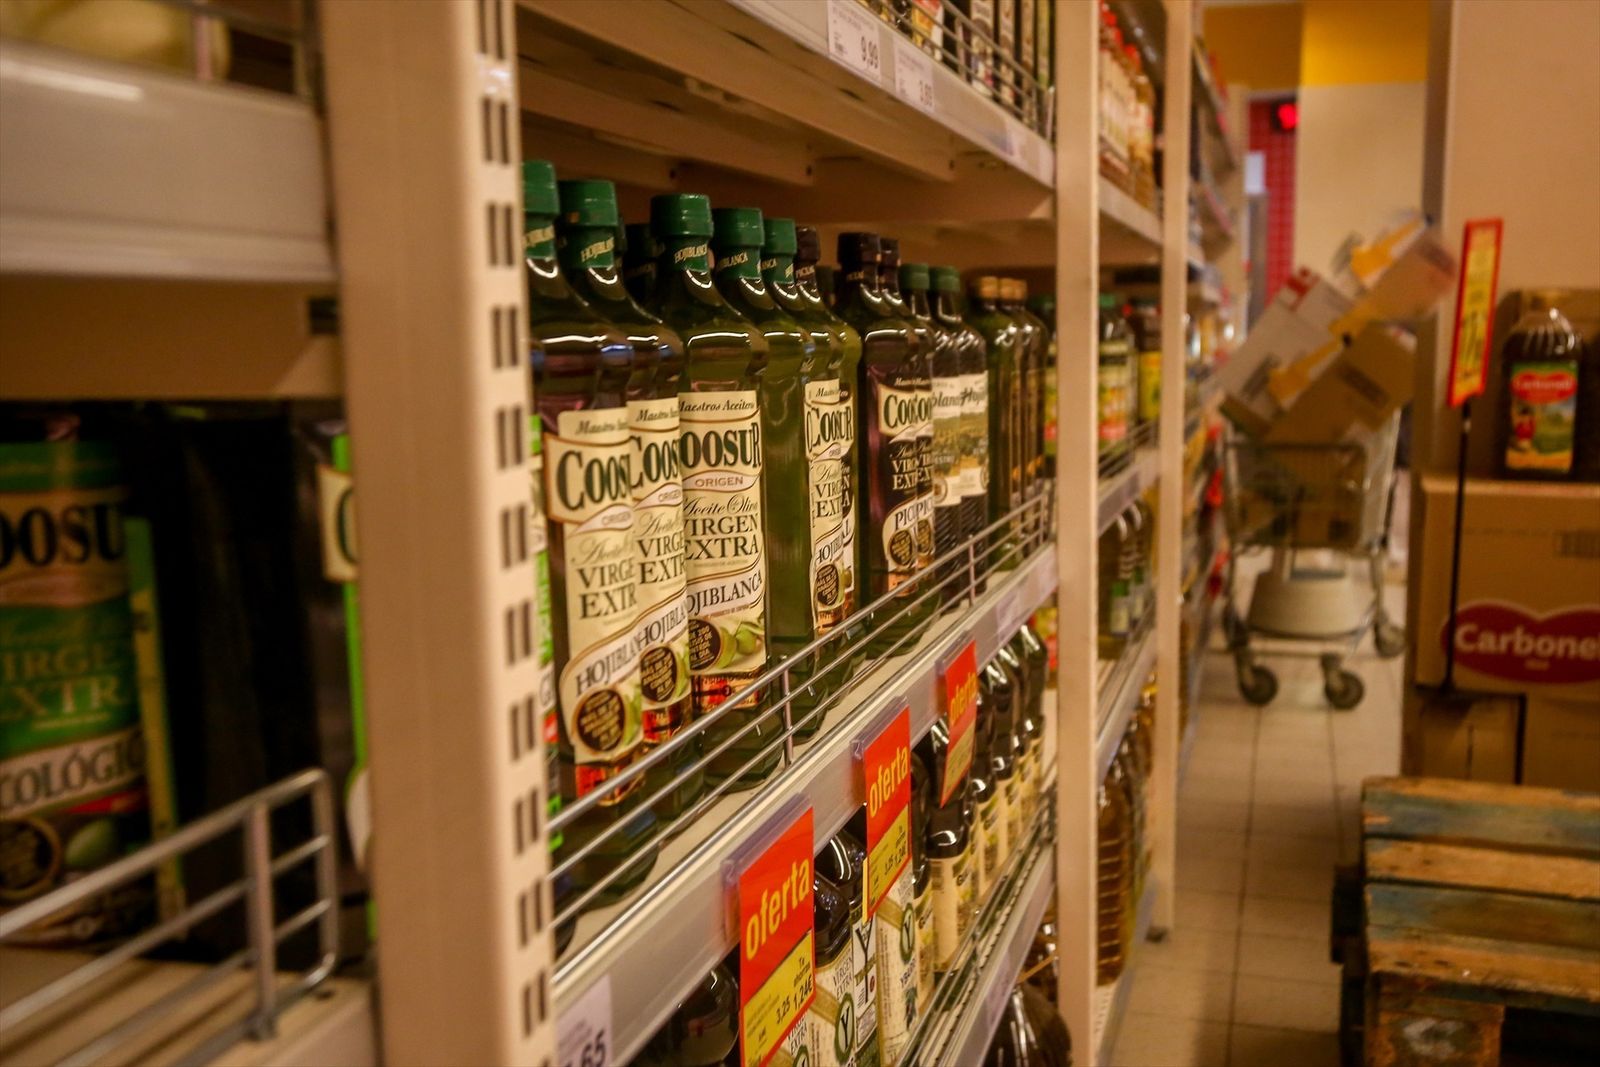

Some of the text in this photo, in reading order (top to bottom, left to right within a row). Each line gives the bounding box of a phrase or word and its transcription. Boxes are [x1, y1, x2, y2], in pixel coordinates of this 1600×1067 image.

[680, 422, 761, 469] OOSUR
[694, 476, 744, 488] ORIGEN
[951, 671, 977, 726] oferta
[869, 746, 908, 819] oferta
[746, 859, 810, 961] oferta
[793, 973, 813, 1010] 1,24€
